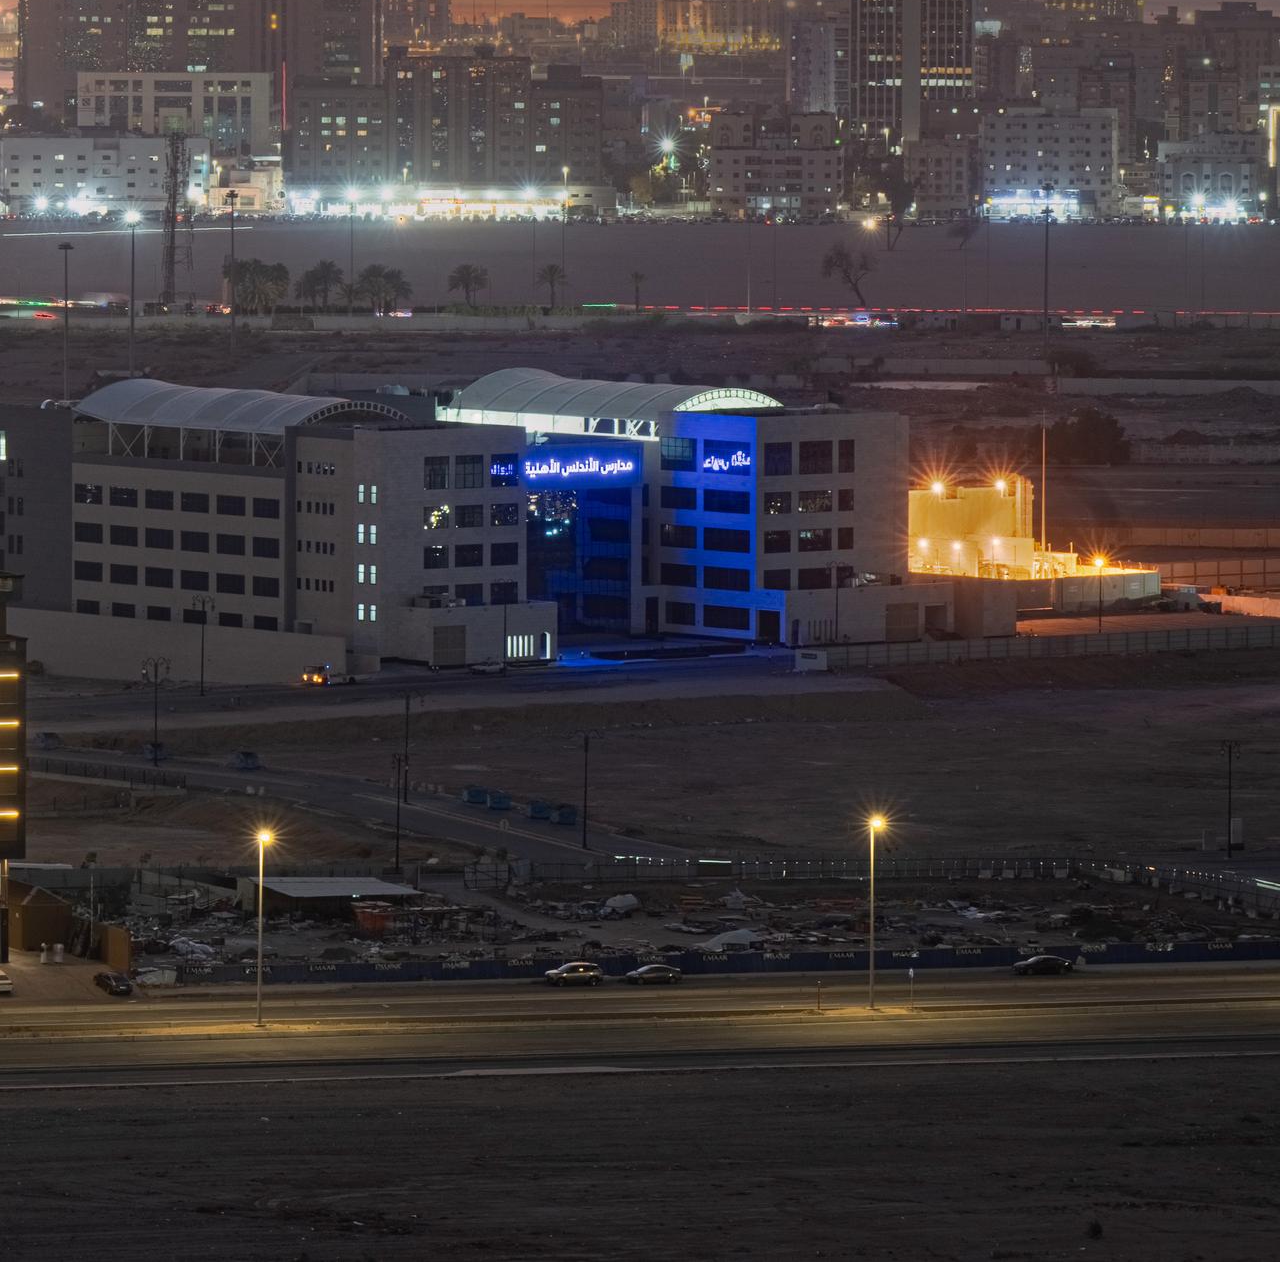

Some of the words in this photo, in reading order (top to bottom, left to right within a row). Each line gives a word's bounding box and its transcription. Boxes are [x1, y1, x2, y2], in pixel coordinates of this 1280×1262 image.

[525, 458, 561, 478] الأهلية
[561, 457, 599, 477] الأندلس
[601, 459, 633, 475] مدارس
